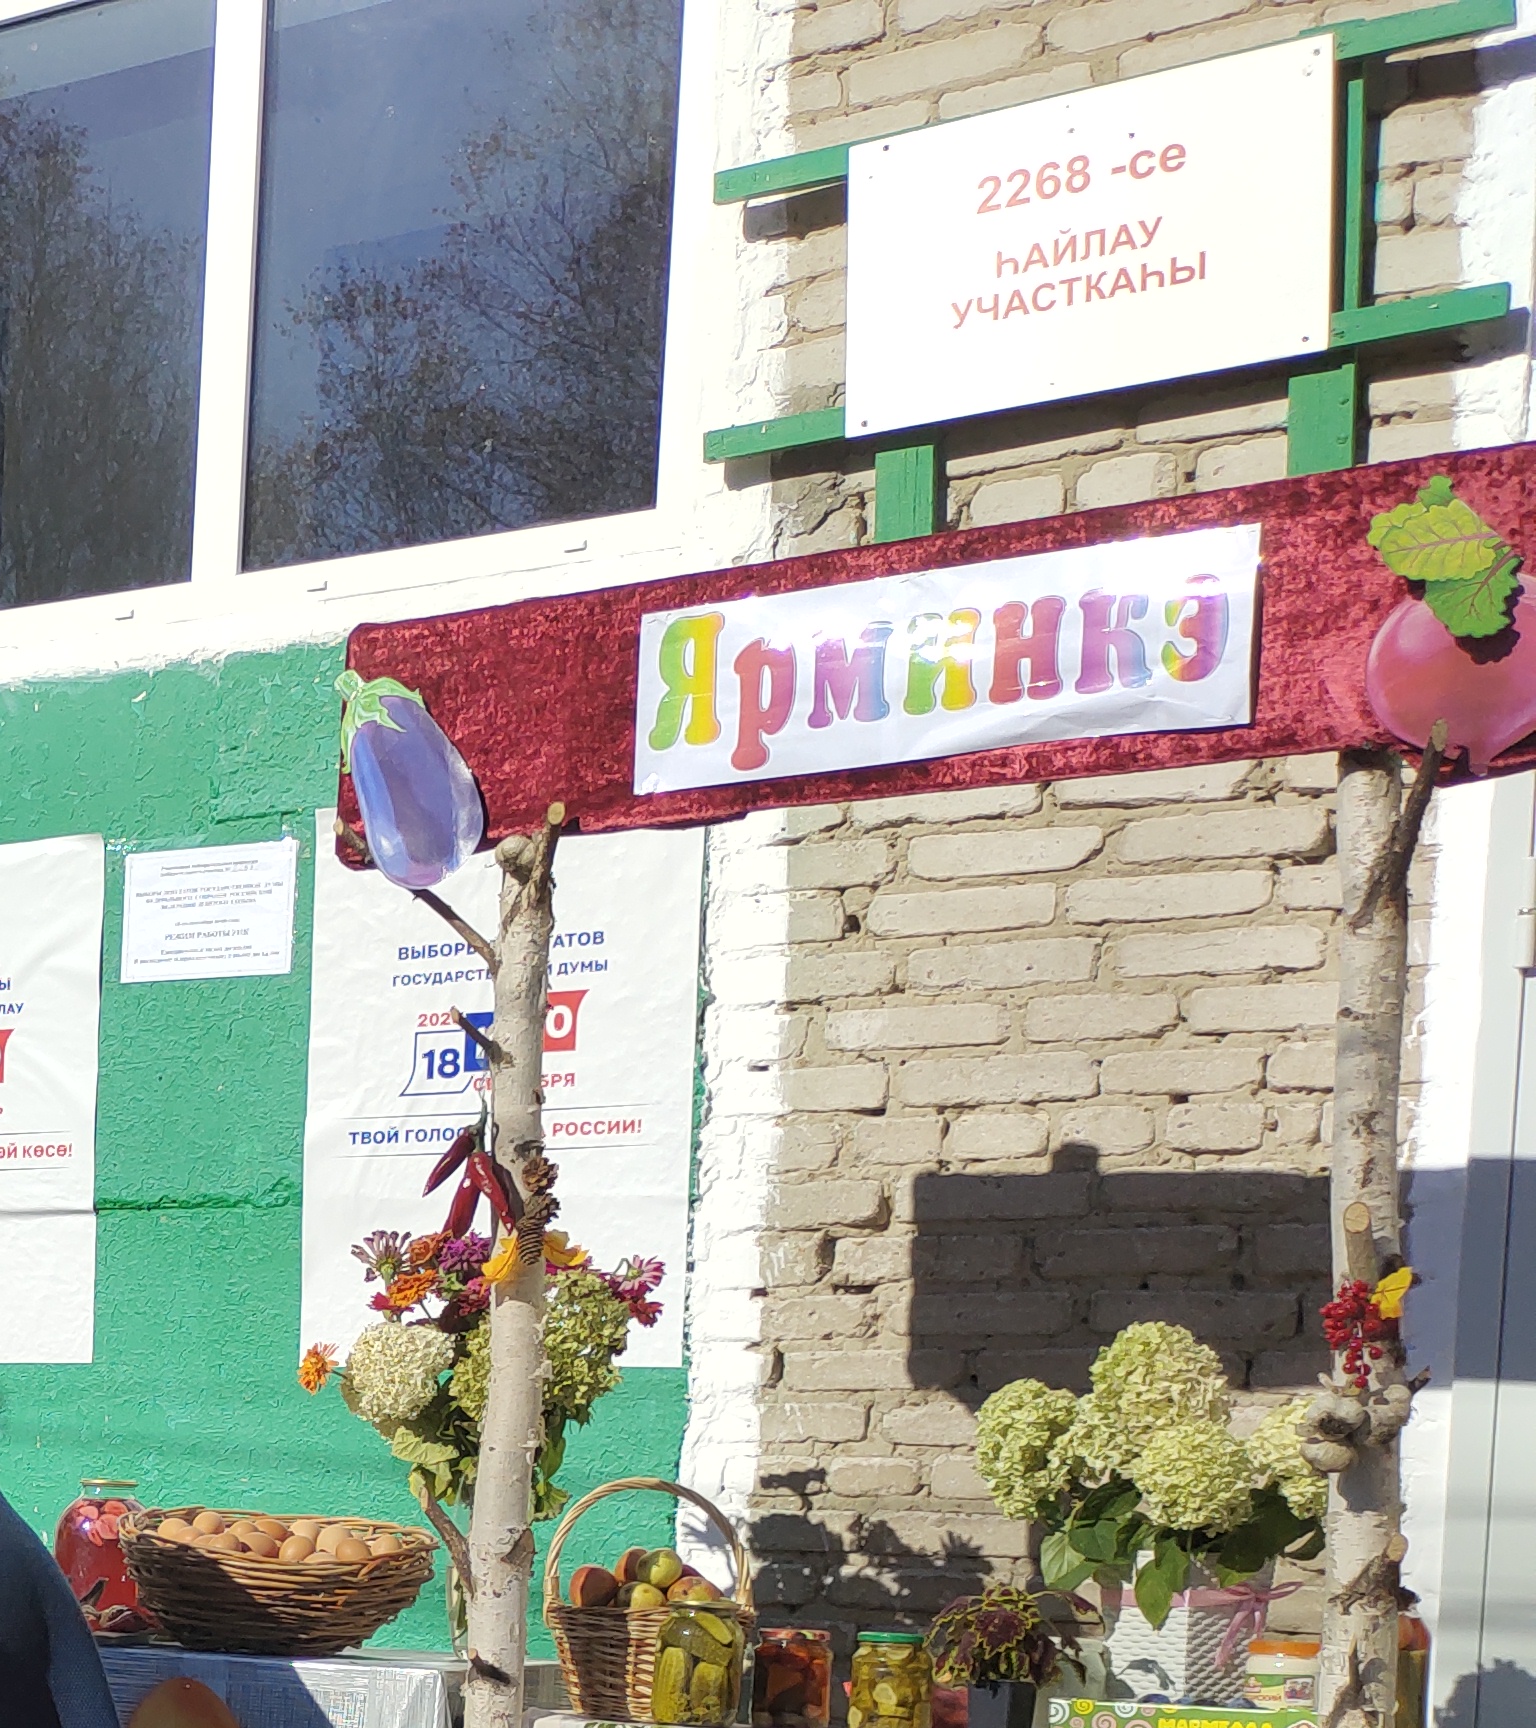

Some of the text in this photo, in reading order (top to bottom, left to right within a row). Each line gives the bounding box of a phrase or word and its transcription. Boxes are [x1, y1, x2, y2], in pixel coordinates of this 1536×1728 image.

[975, 141, 1188, 215] 2268 -се
[995, 215, 1164, 279] ҺАЙЛАУ
[950, 250, 1206, 330] УЧАСТКАҺЫ
[556, 958, 609, 977] ДУМЫ
[417, 1012, 460, 1028] 202
[421, 1004, 574, 1080] 18 0
[22, 1142, 74, 1160] КӨСӨ!
[348, 1126, 400, 1146] ТВОЙ
[552, 1118, 643, 1137] РОССИИ!
